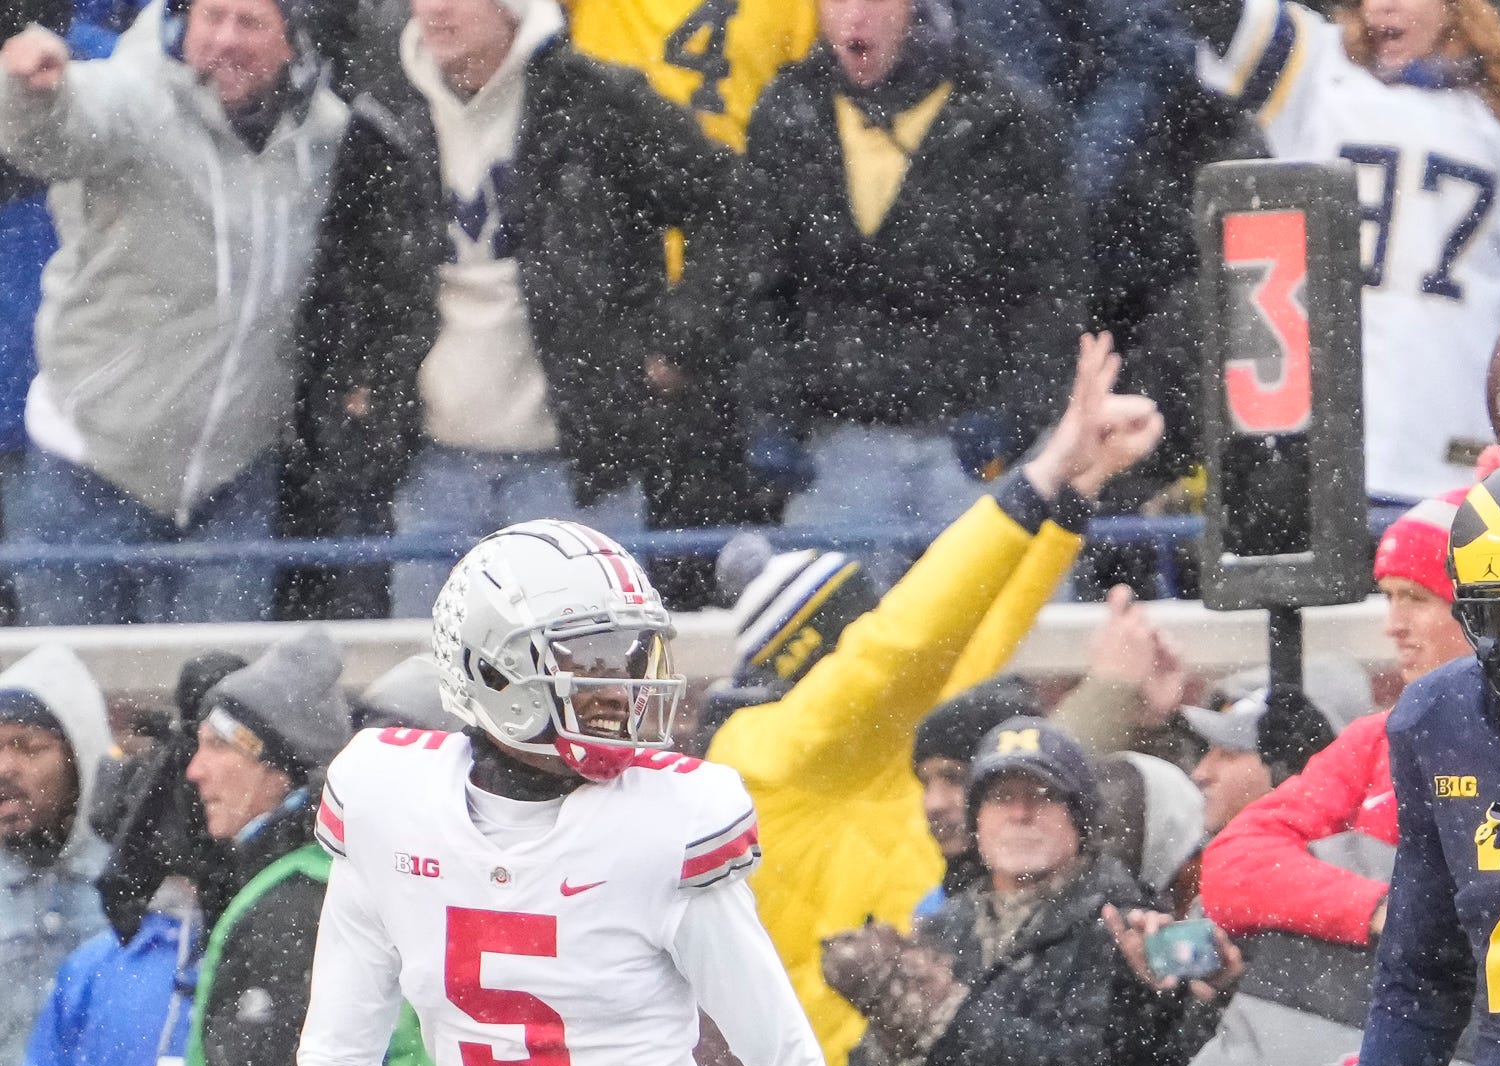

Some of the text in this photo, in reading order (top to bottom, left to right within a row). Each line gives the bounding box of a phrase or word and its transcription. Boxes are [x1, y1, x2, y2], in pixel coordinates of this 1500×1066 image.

[664, 0, 739, 114] 4
[1223, 208, 1312, 434] 3
[997, 728, 1041, 753] M
